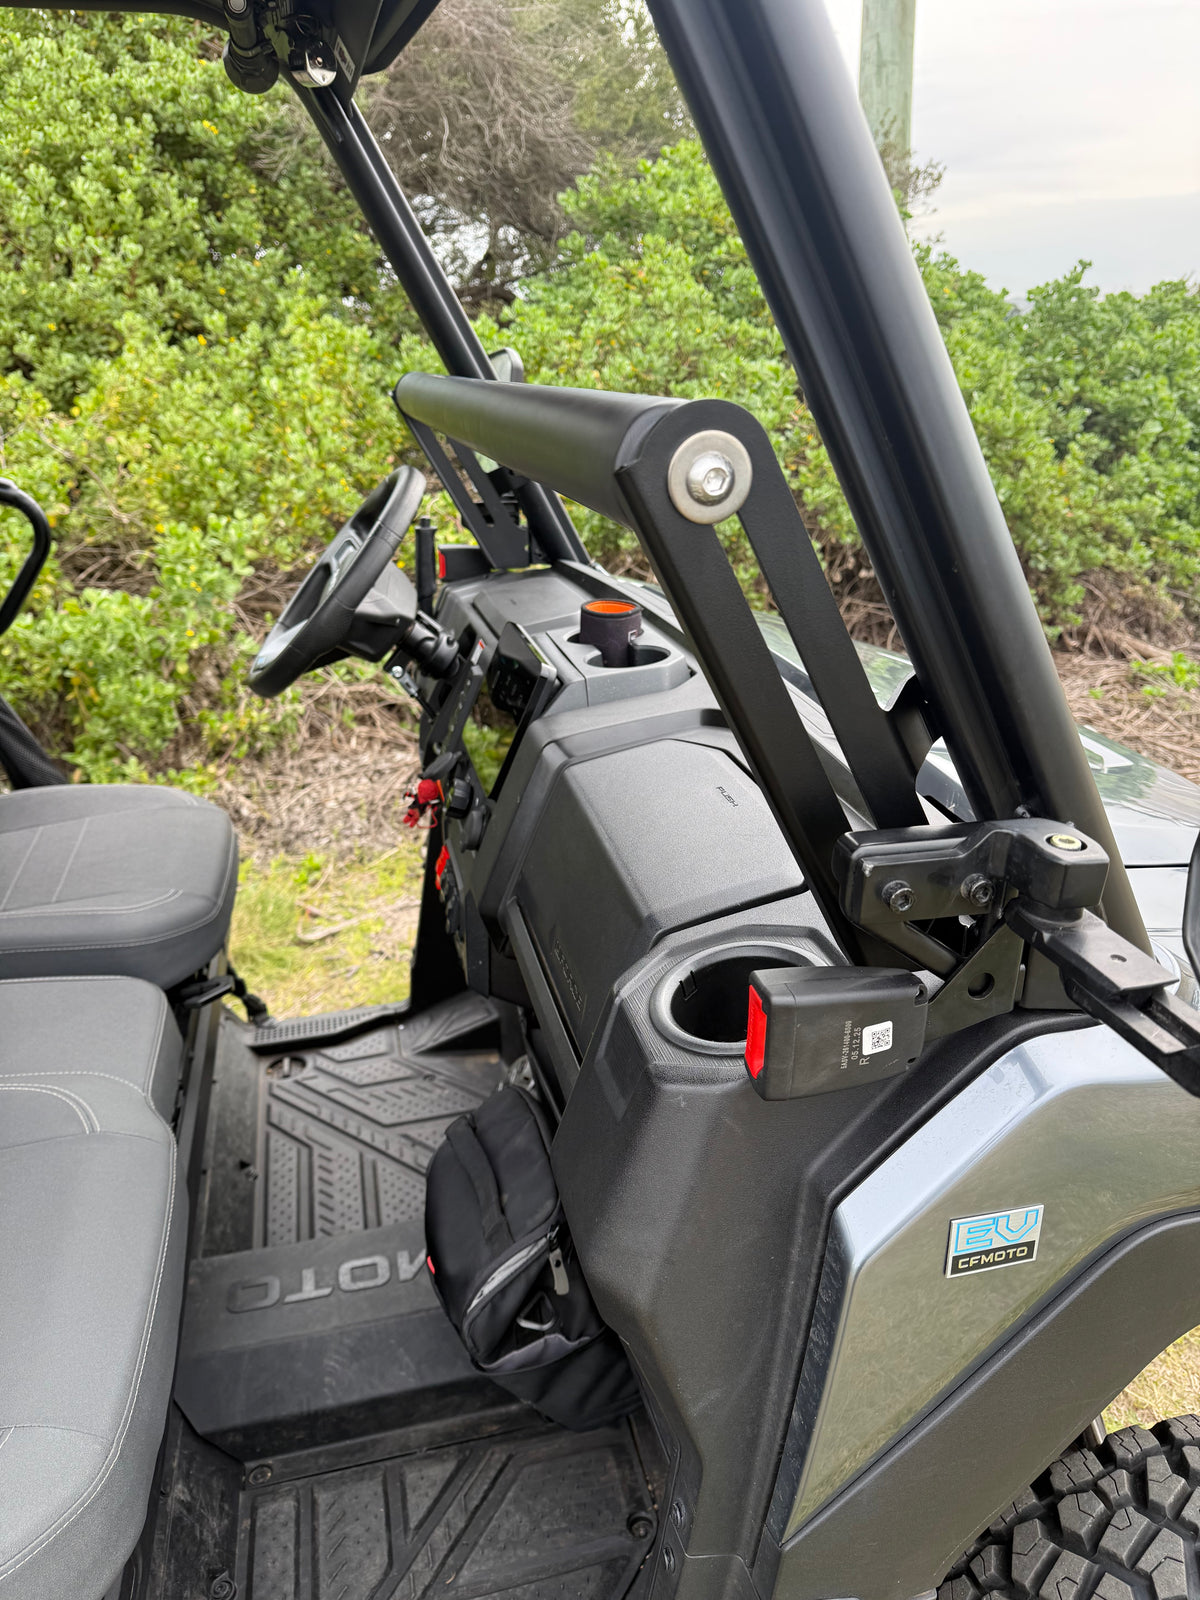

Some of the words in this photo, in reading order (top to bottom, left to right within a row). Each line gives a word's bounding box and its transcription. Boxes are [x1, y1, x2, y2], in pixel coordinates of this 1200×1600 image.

[716, 786, 739, 807] PUSH
[851, 1027, 862, 1060] 05.12.25
[859, 1056, 870, 1066] R
[954, 1209, 1039, 1254] EV
[958, 1246, 1028, 1269] CFMOTO
